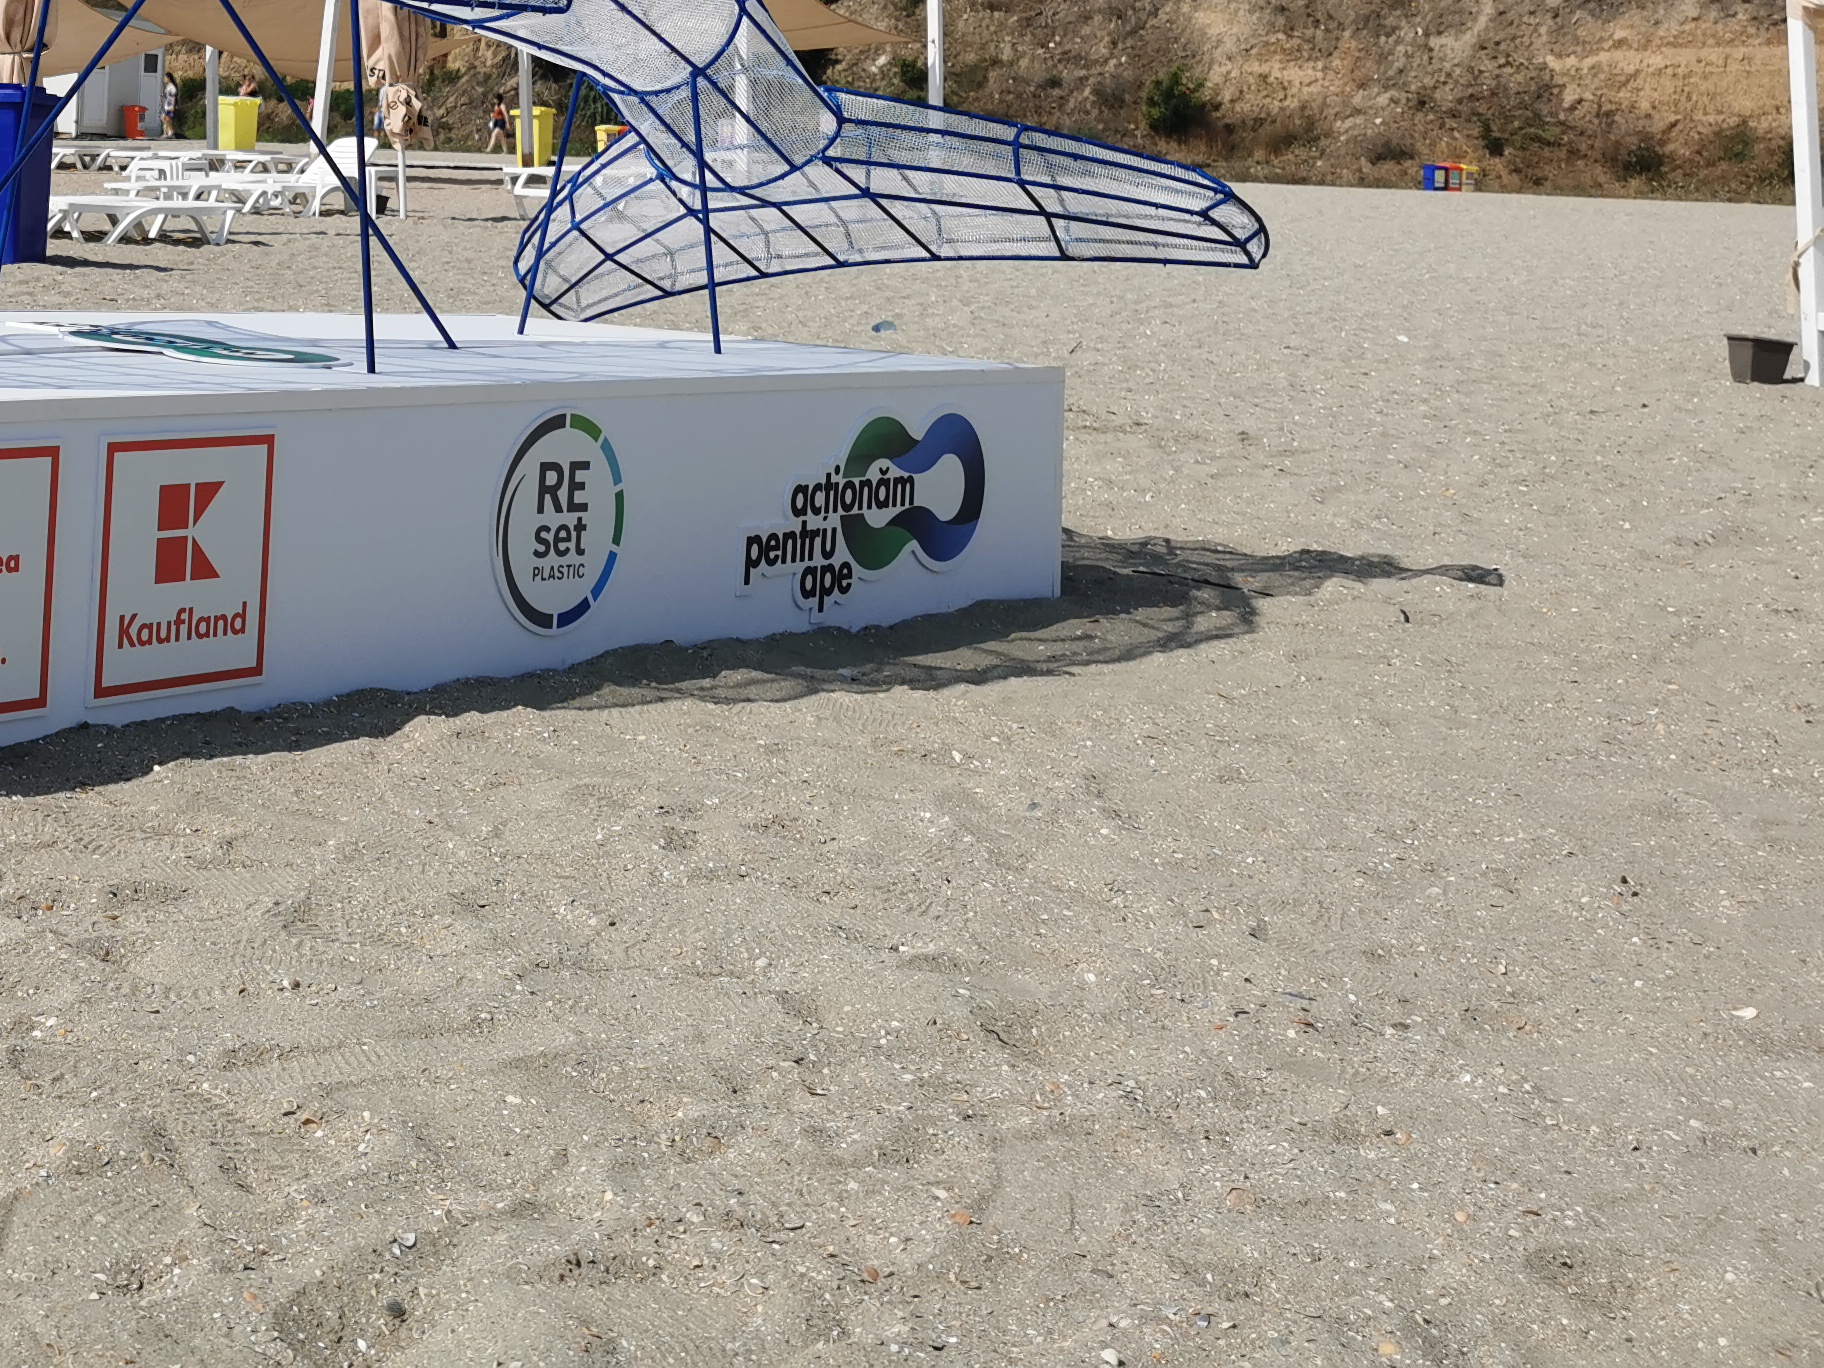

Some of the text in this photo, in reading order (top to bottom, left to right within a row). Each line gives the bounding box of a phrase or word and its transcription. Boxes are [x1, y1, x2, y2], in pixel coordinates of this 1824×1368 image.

[536, 460, 592, 515] RE
[790, 464, 915, 521] acționăm
[532, 516, 587, 560] set
[743, 520, 837, 586] pentru
[532, 562, 586, 583] PLASTIC
[799, 561, 853, 613] ape
[117, 600, 248, 650] Kaufland
